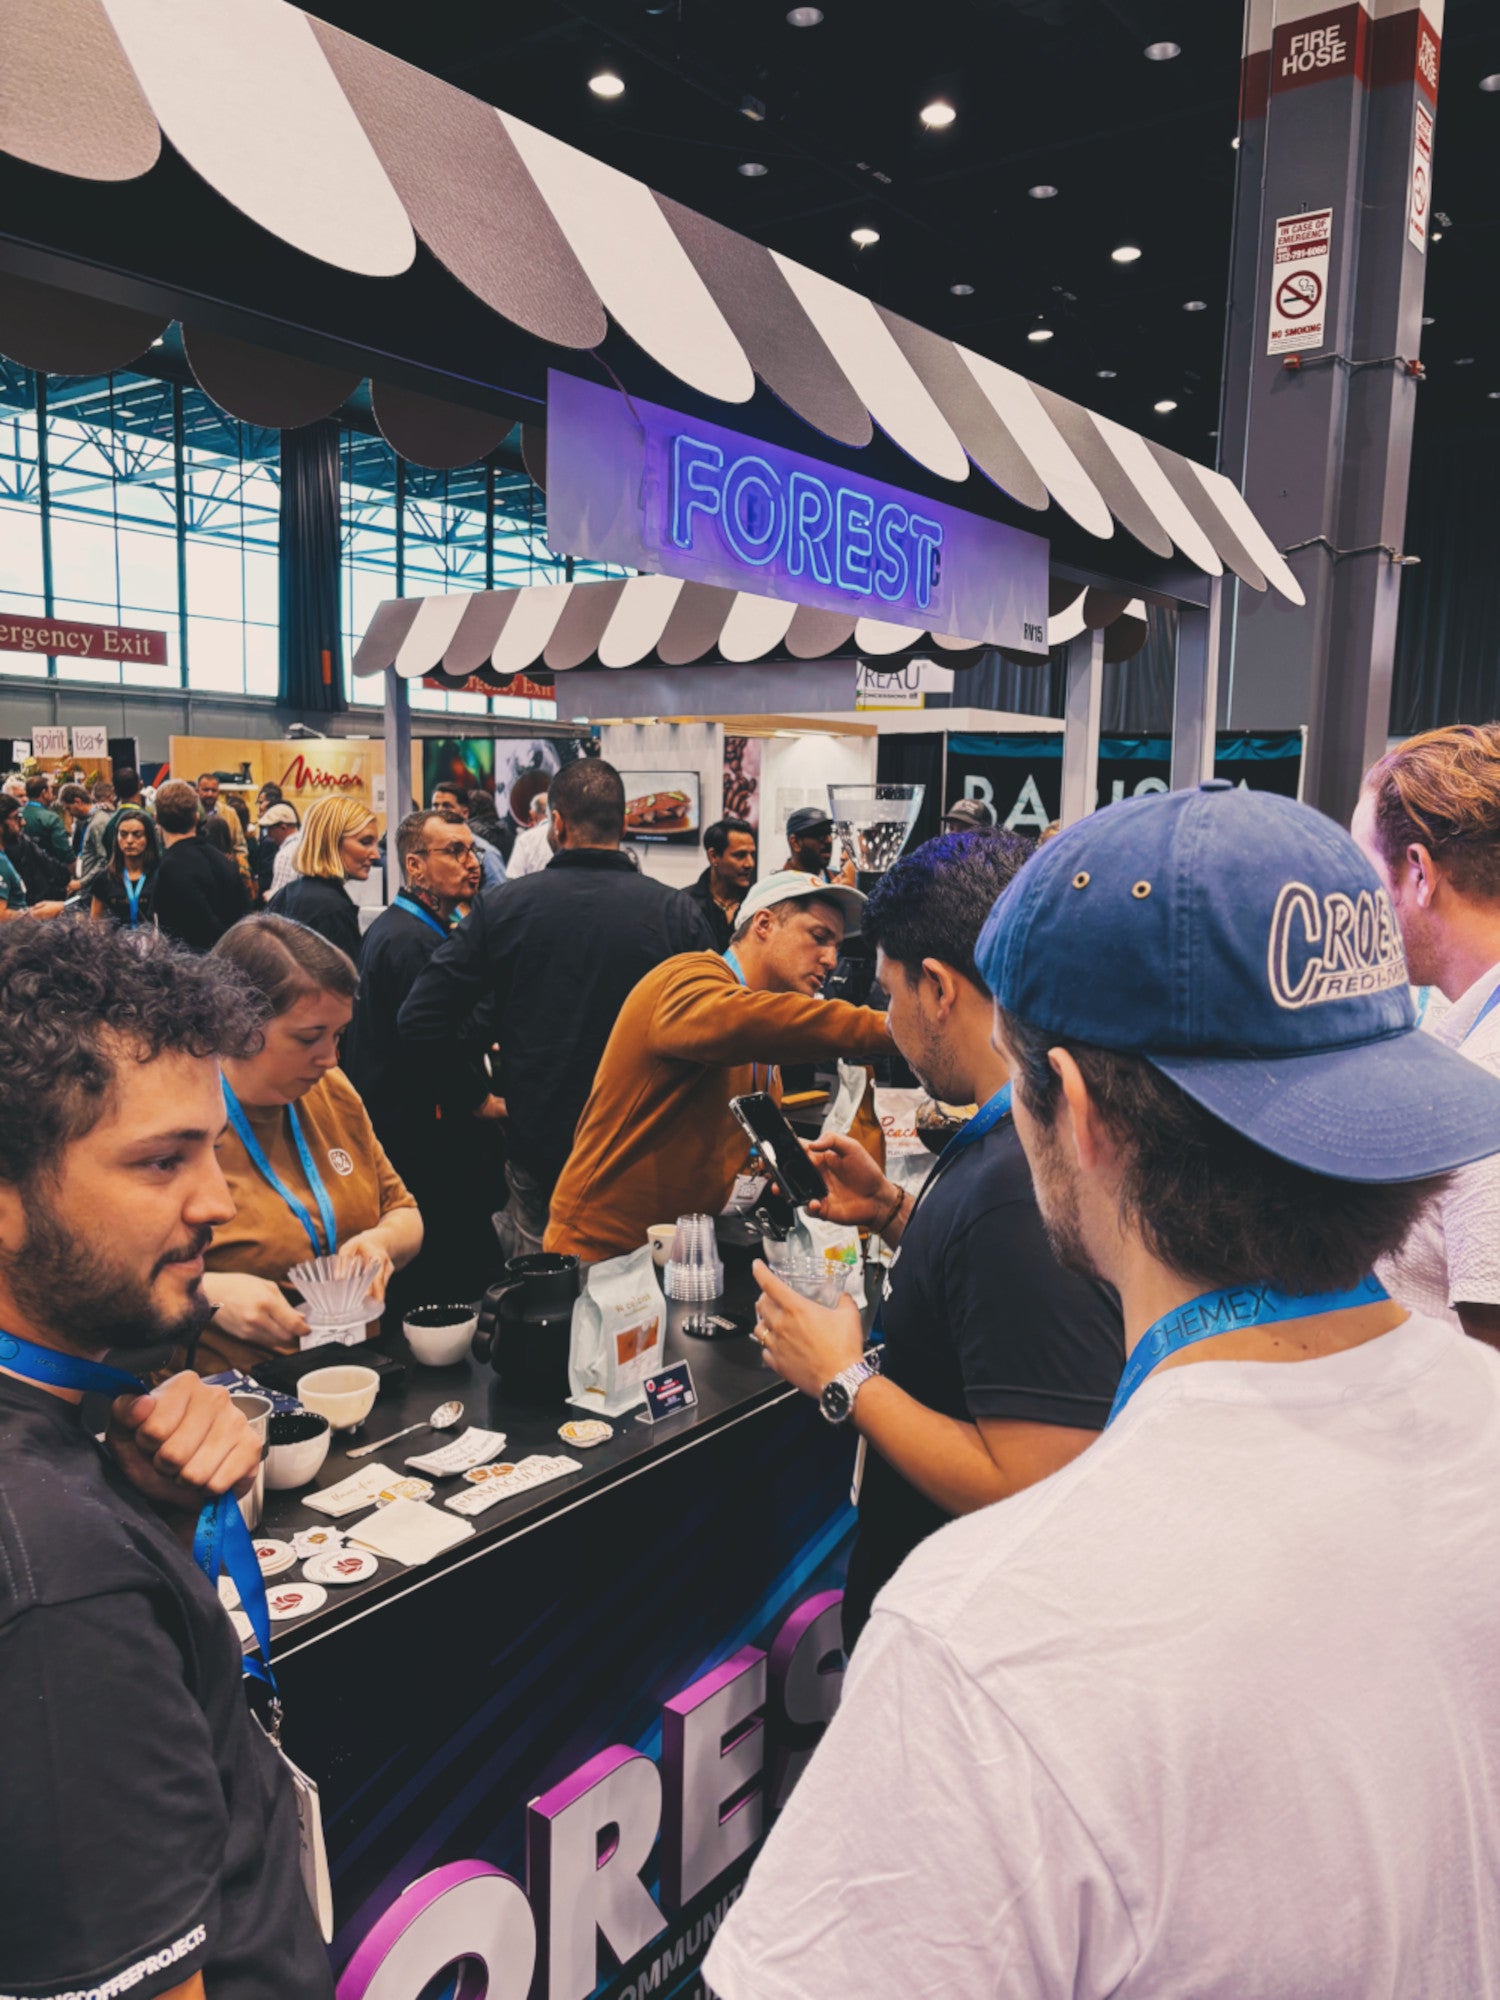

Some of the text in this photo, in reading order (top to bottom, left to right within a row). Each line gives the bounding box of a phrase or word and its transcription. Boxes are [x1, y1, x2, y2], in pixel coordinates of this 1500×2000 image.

[1291, 25, 1341, 56] FIRE
[1281, 42, 1347, 76] HOSE
[1278, 228, 1328, 245] EMERGENCY
[1281, 219, 1327, 236] IN CASE OF
[1272, 324, 1322, 339] NO SMOKING
[672, 434, 943, 609] FOREST
[103, 629, 152, 657] Exit
[34, 730, 95, 755] spirit tea
[1150, 1285, 1278, 1356] CHEMEX
